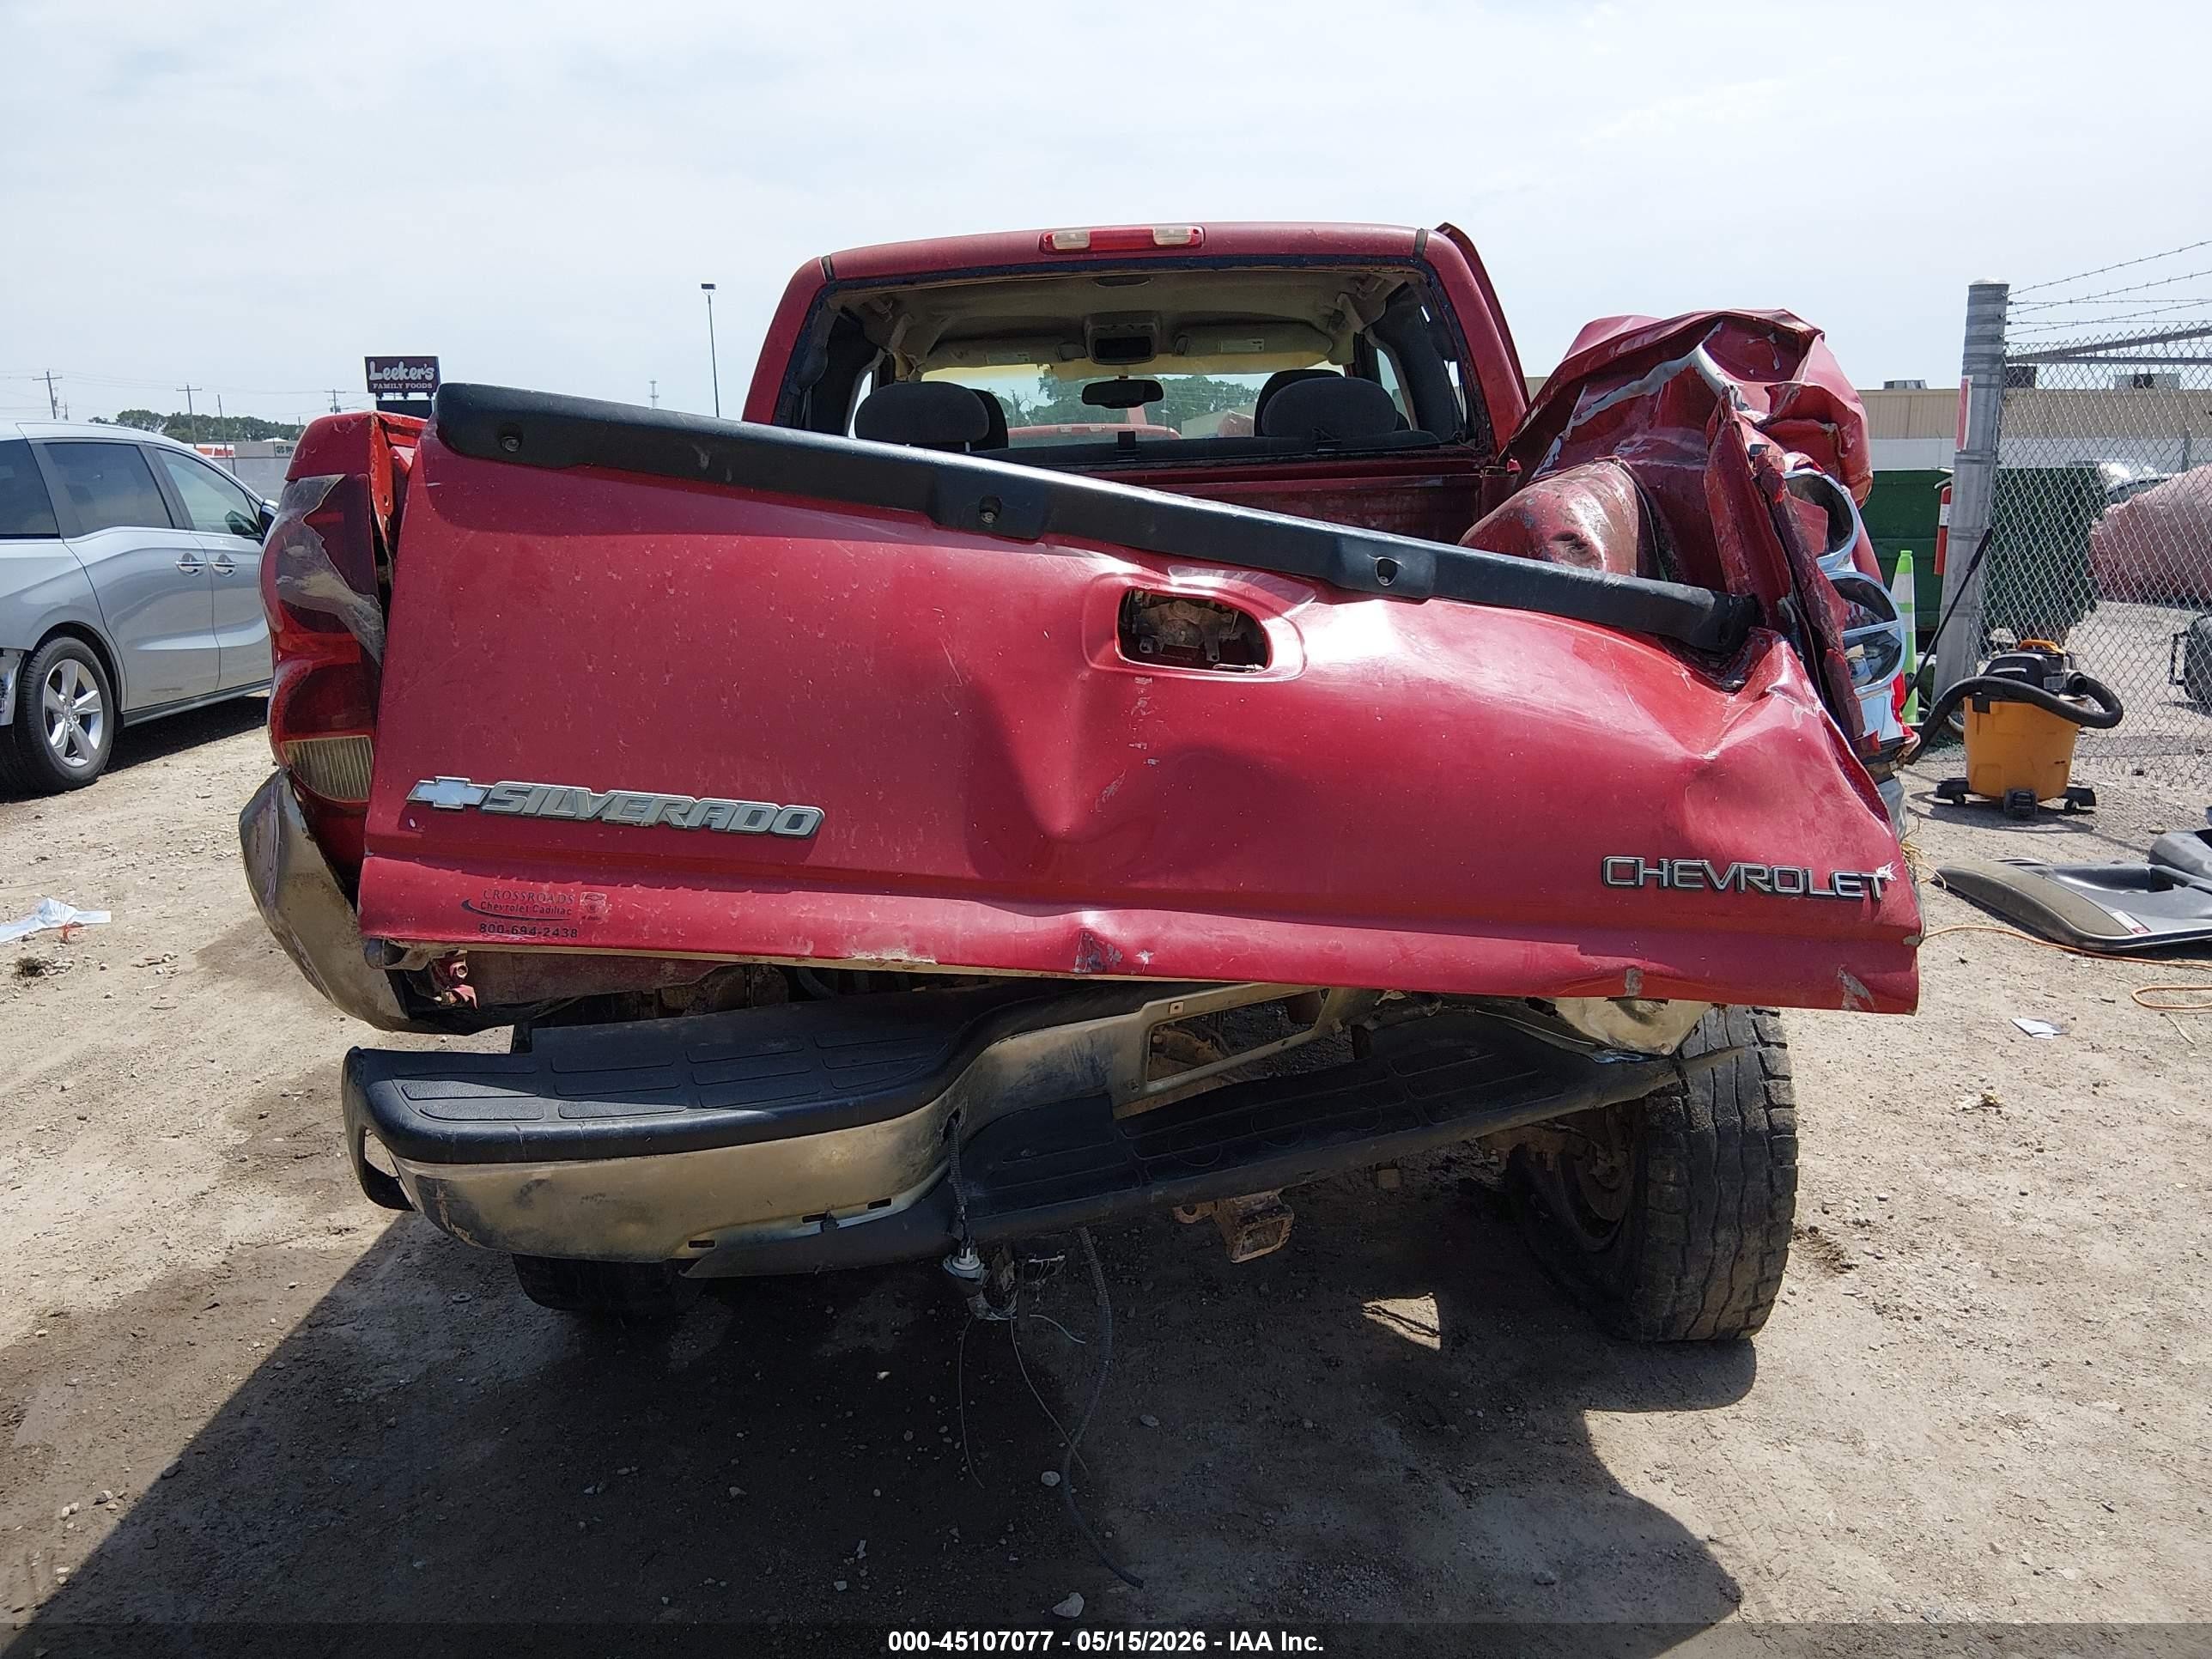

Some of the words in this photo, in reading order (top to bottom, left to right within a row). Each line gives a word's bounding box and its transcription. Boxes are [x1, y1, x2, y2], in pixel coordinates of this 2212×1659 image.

[368, 361, 435, 380] Leeker's
[482, 781, 825, 838] SILVERADO
[1602, 856, 1887, 900] CHEVROLET
[483, 888, 576, 904] CROSSROADS
[480, 901, 530, 914] Chevrolet
[532, 905, 573, 916] Cadillac
[478, 922, 579, 939] 800-694-2438
